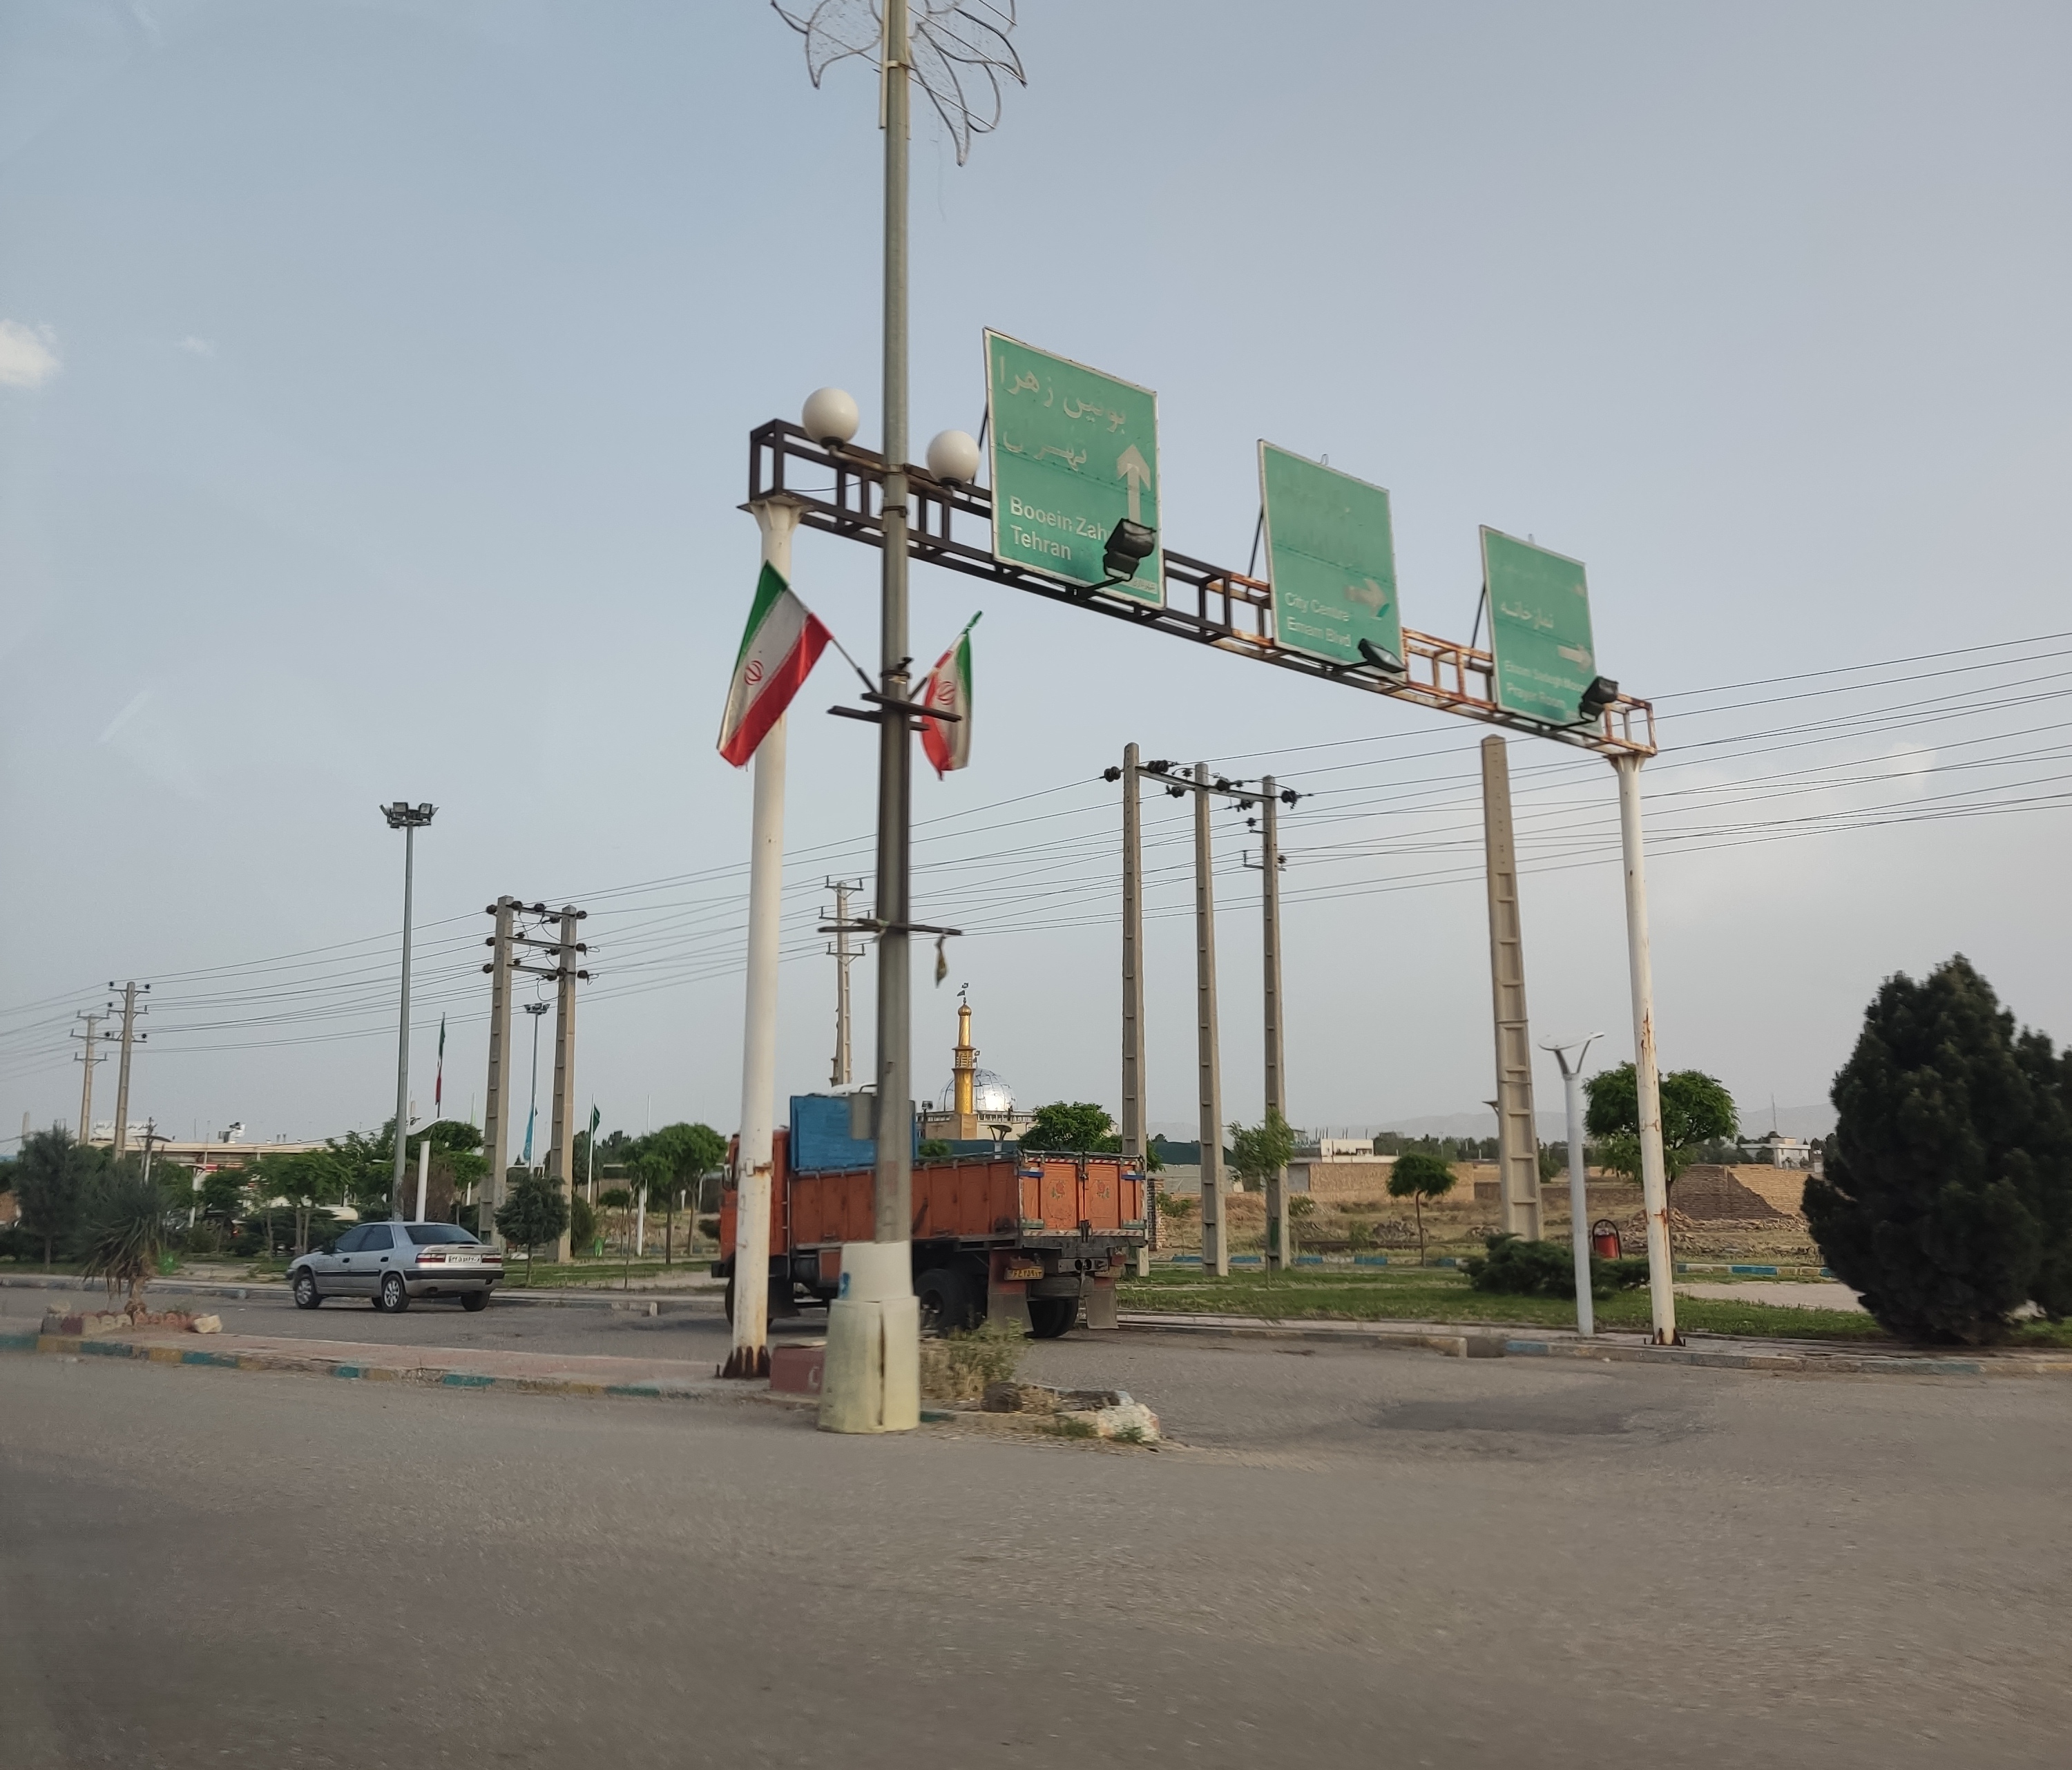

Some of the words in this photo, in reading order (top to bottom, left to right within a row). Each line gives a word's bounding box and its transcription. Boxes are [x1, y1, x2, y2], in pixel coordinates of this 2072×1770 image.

[999, 356, 1053, 408] زهرا
[1010, 495, 1073, 532] Booein
[1010, 524, 1071, 560] Tehran
